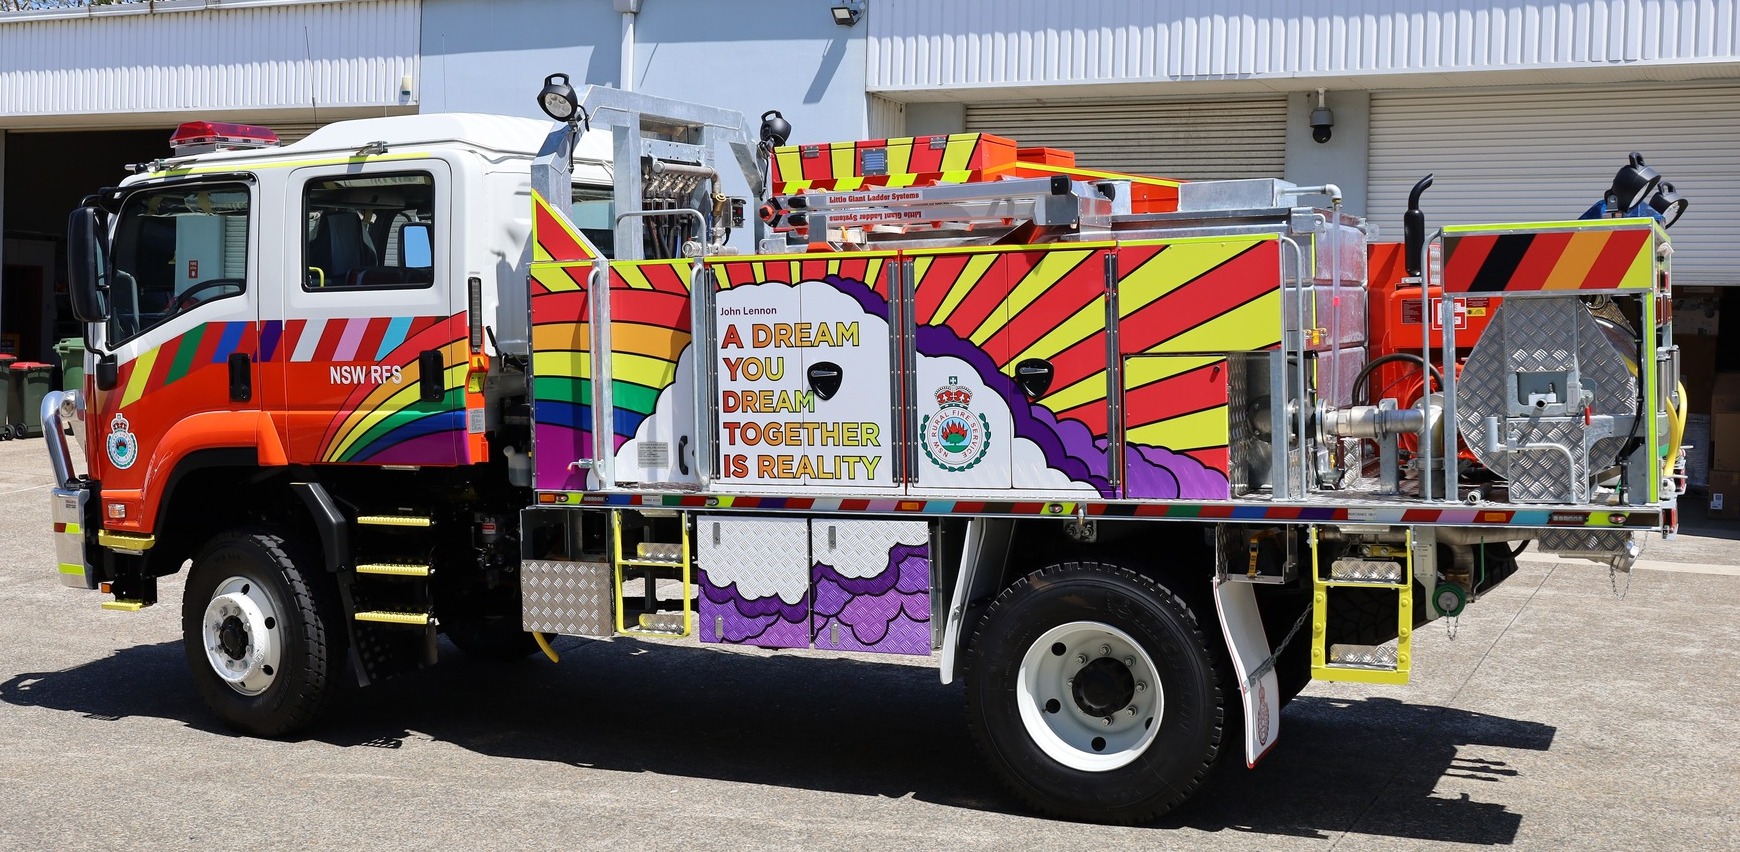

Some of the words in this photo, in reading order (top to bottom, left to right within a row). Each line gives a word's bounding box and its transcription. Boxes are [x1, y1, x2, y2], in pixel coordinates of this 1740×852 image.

[829, 196, 847, 204] Little
[848, 195, 866, 203] Giant
[867, 194, 890, 202] Ladder
[891, 192, 920, 201] Systems
[860, 212, 882, 220] Ladder
[885, 212, 902, 220] Giant
[720, 307, 741, 316] John
[743, 306, 777, 316] Lennon
[721, 324, 744, 349] A
[752, 321, 860, 348] DREAM
[330, 366, 366, 384] NSW
[370, 365, 403, 384] RFS
[722, 356, 785, 382] YOU
[722, 390, 816, 413] DREAM
[931, 412, 949, 437] RURAL
[952, 410, 971, 421] FIRE
[723, 421, 882, 446] TOGETHER
[962, 422, 979, 458] SERVICE
[933, 441, 949, 458] NSW
[723, 454, 749, 479] IS
[757, 454, 882, 480] REALITY
